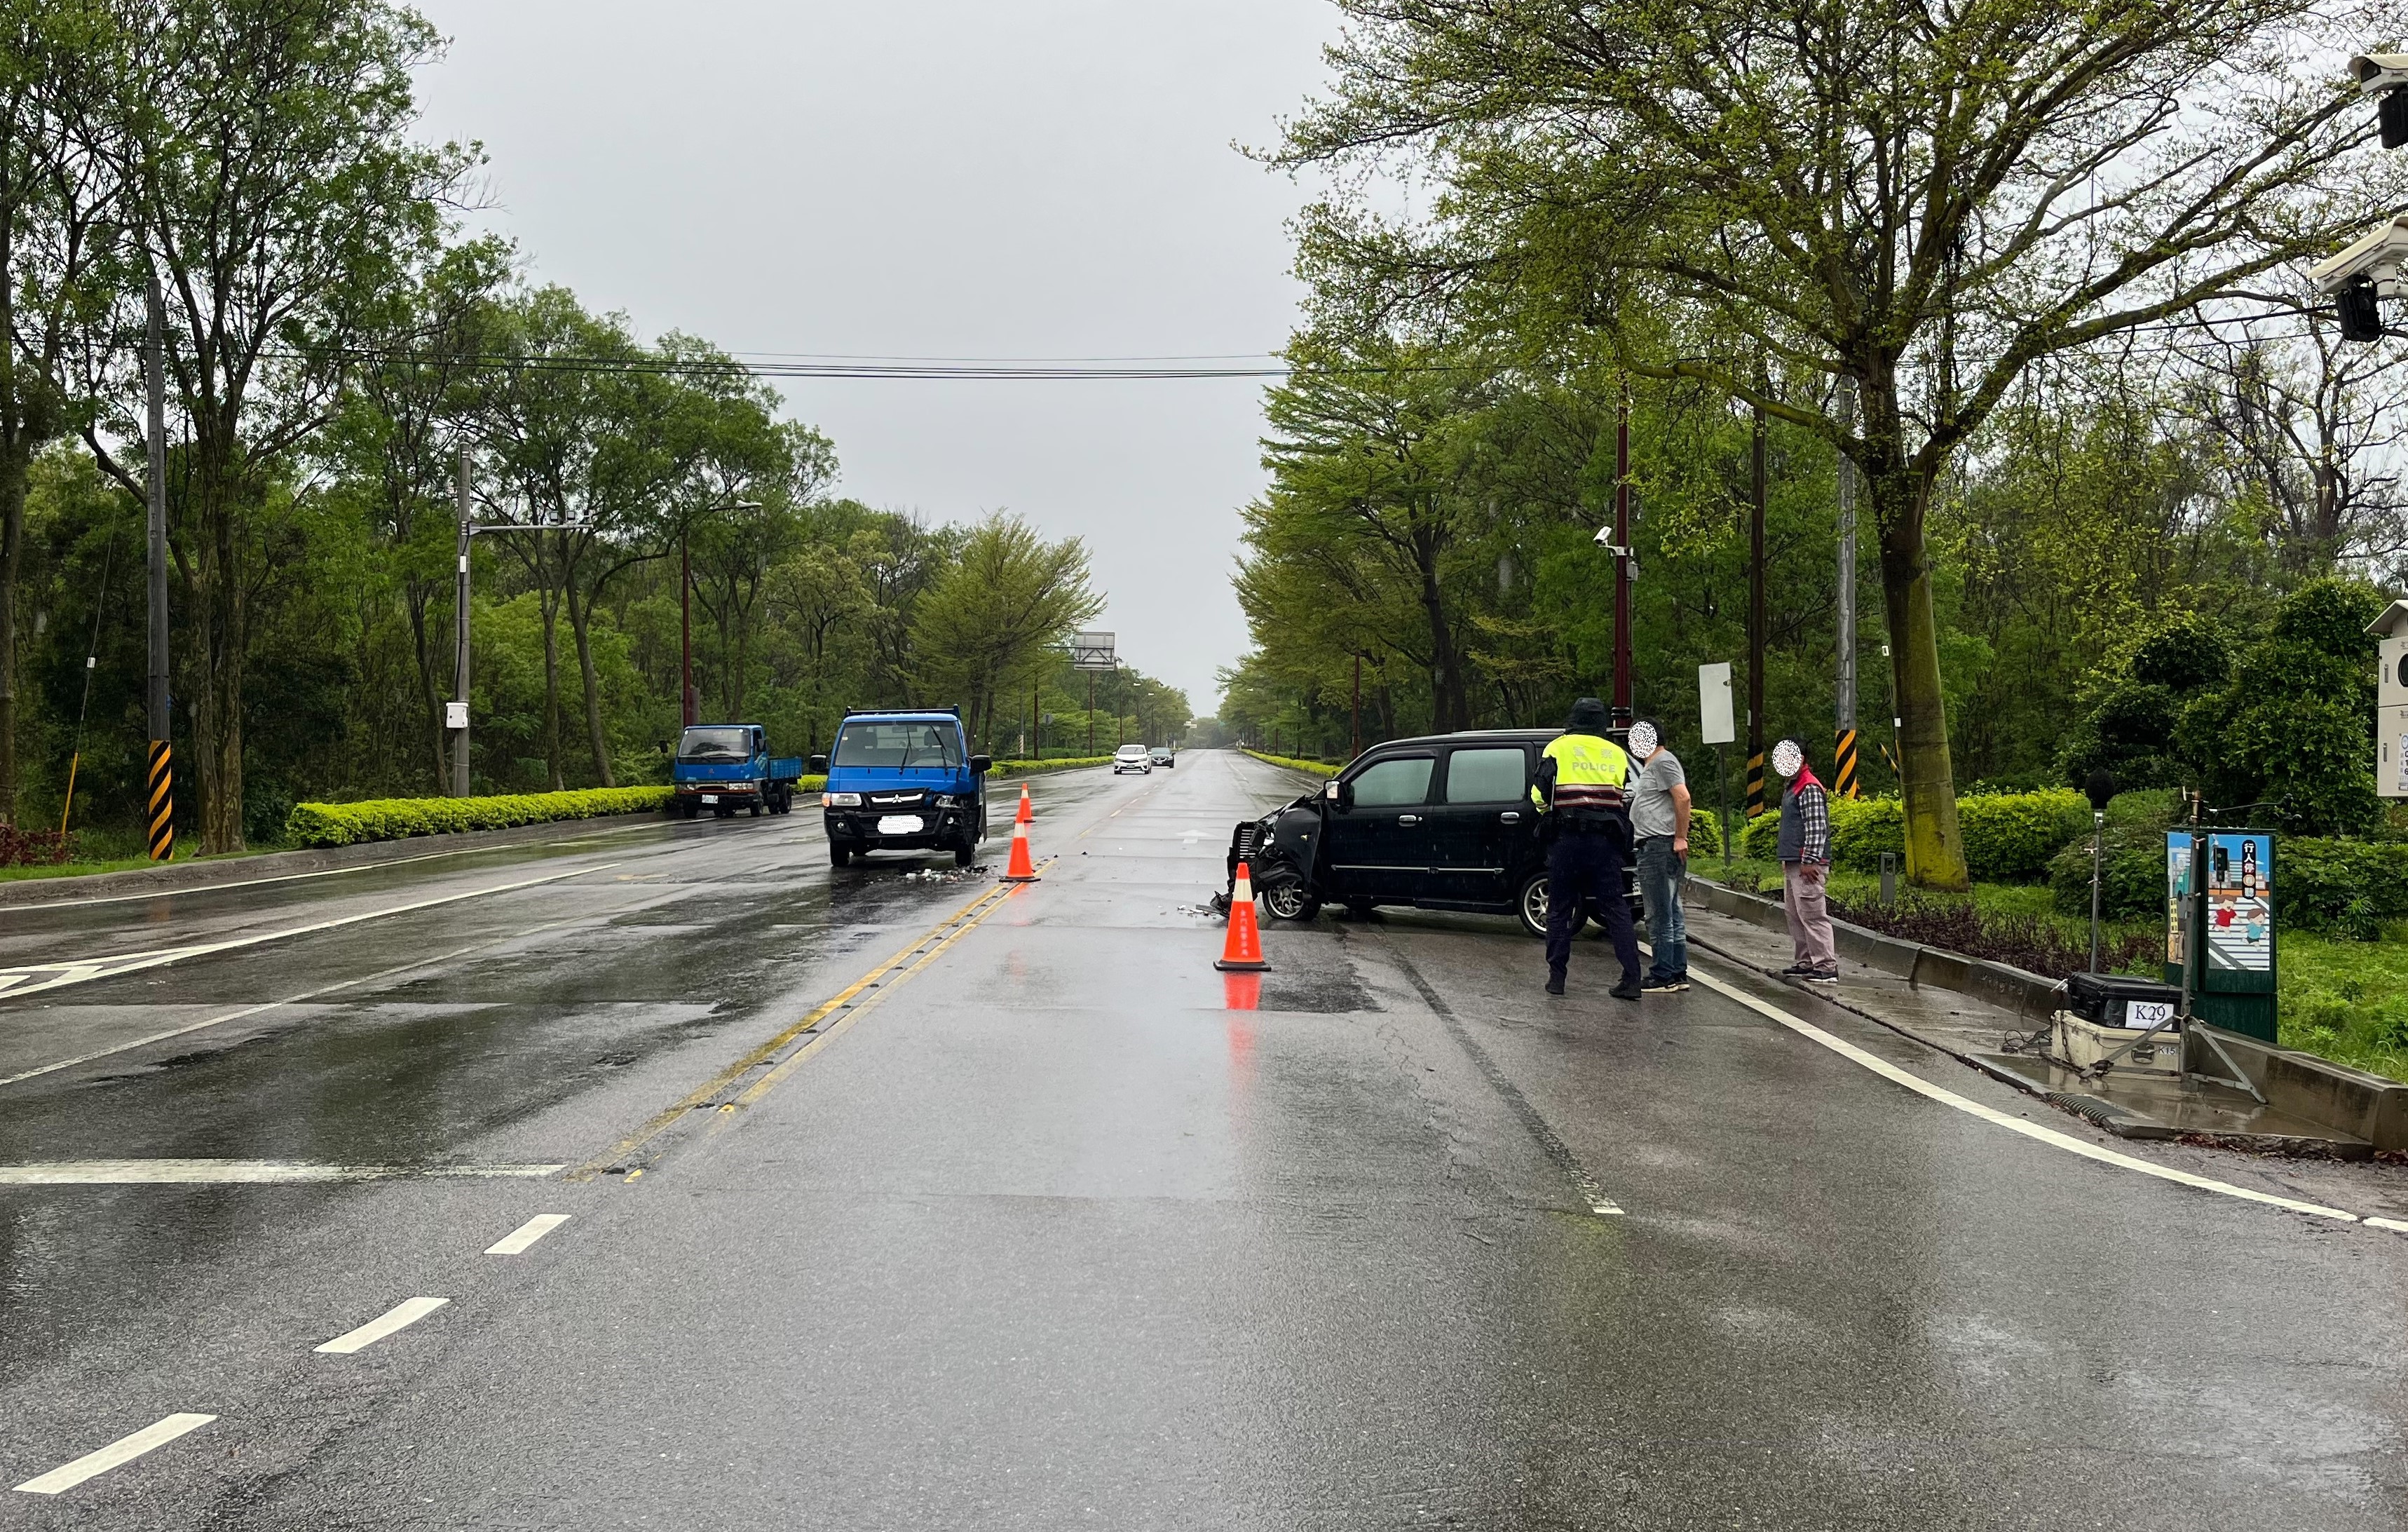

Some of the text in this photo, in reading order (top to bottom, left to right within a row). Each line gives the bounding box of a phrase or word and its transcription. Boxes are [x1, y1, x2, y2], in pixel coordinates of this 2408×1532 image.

[1572, 761, 1615, 772] POLICE
[2135, 1005, 2165, 1021] K29
[2158, 1045, 2175, 1055] K15
